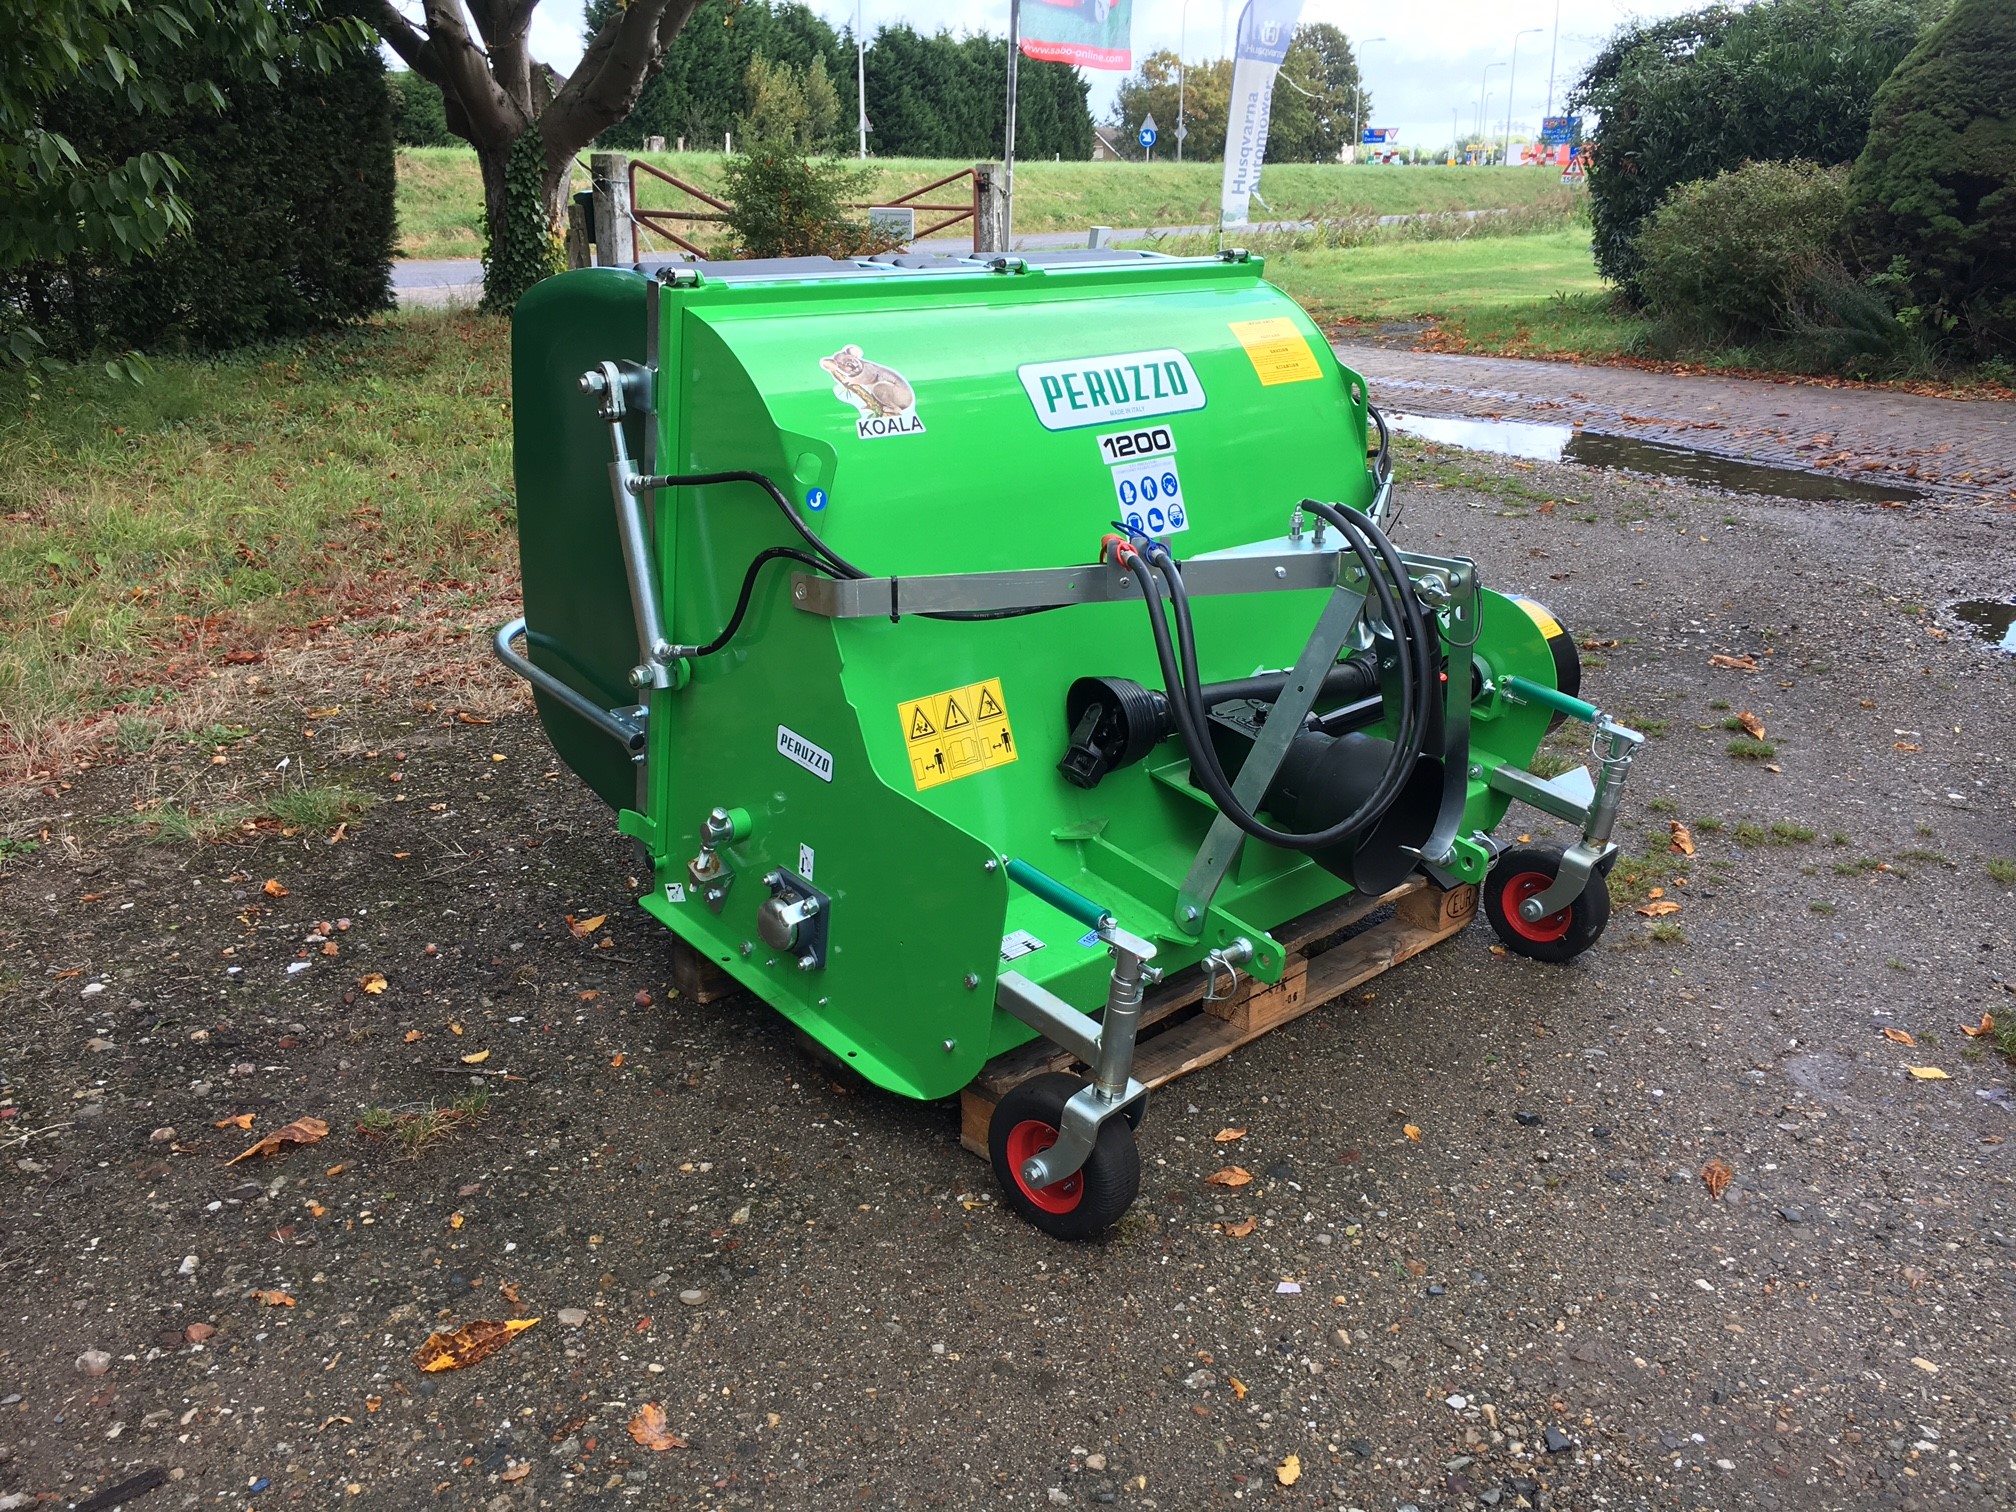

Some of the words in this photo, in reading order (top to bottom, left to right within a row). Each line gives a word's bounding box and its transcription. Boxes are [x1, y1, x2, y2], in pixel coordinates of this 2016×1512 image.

[1024, 43, 1123, 63] www.sabo-online.com
[1231, 91, 1259, 195] Husqvarna
[1248, 79, 1273, 193] Automower
[1039, 360, 1189, 413] PERUZZO
[1109, 408, 1125, 416] MADE
[1131, 405, 1145, 413] ITALY
[858, 415, 923, 437] KOALA
[1103, 429, 1171, 458] 1200
[780, 733, 830, 773] PERUZZO
[1452, 887, 1472, 914] EUR
